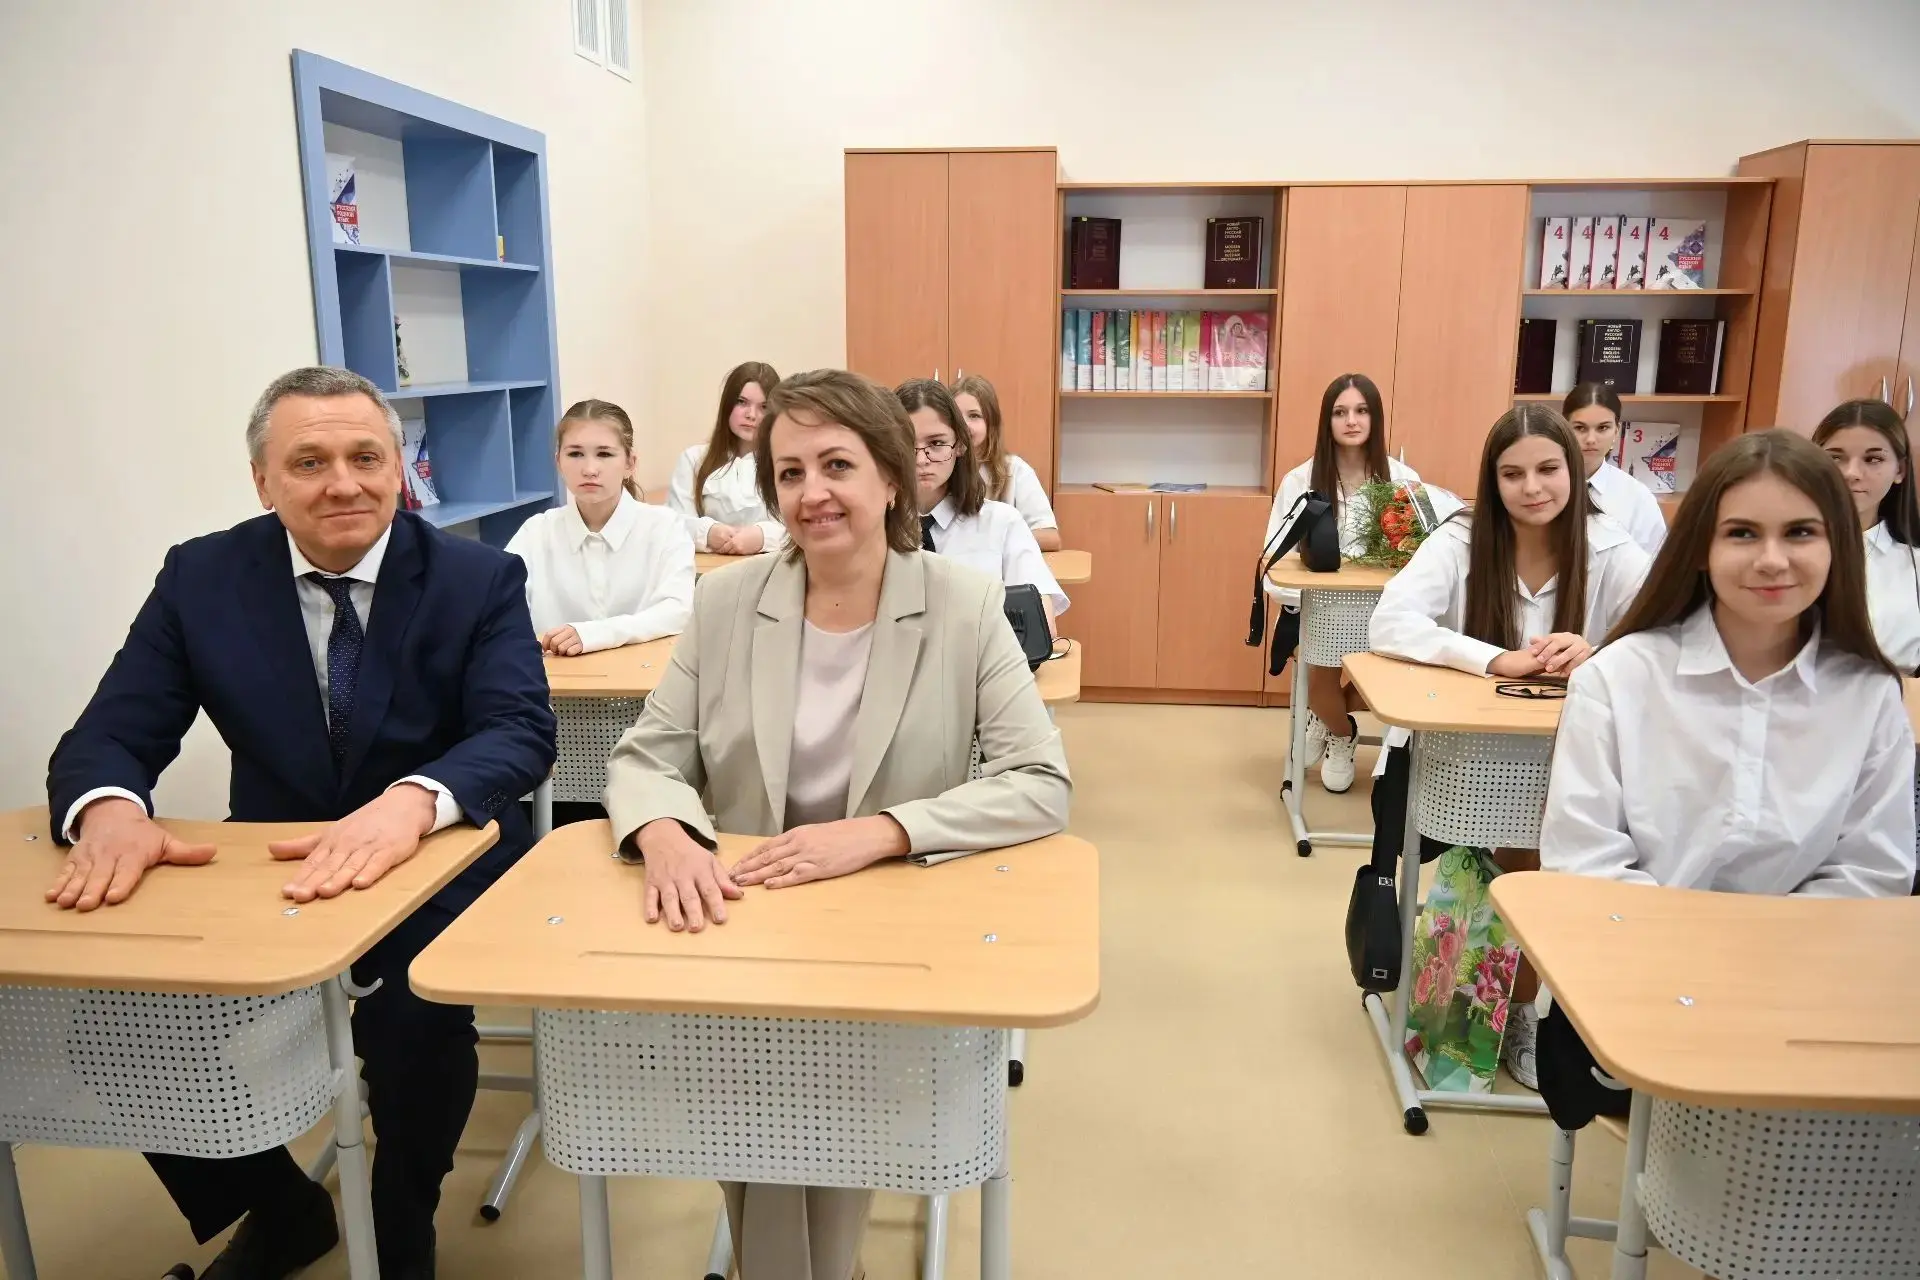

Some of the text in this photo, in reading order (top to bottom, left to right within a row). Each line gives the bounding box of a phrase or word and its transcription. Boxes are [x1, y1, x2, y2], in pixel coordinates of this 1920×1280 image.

[1554, 225, 1563, 240] 4
[1582, 225, 1592, 240] 4
[1604, 225, 1613, 240] 4
[1630, 225, 1640, 240] 4
[1659, 226, 1669, 240] 4
[1633, 429, 1643, 443] 3
